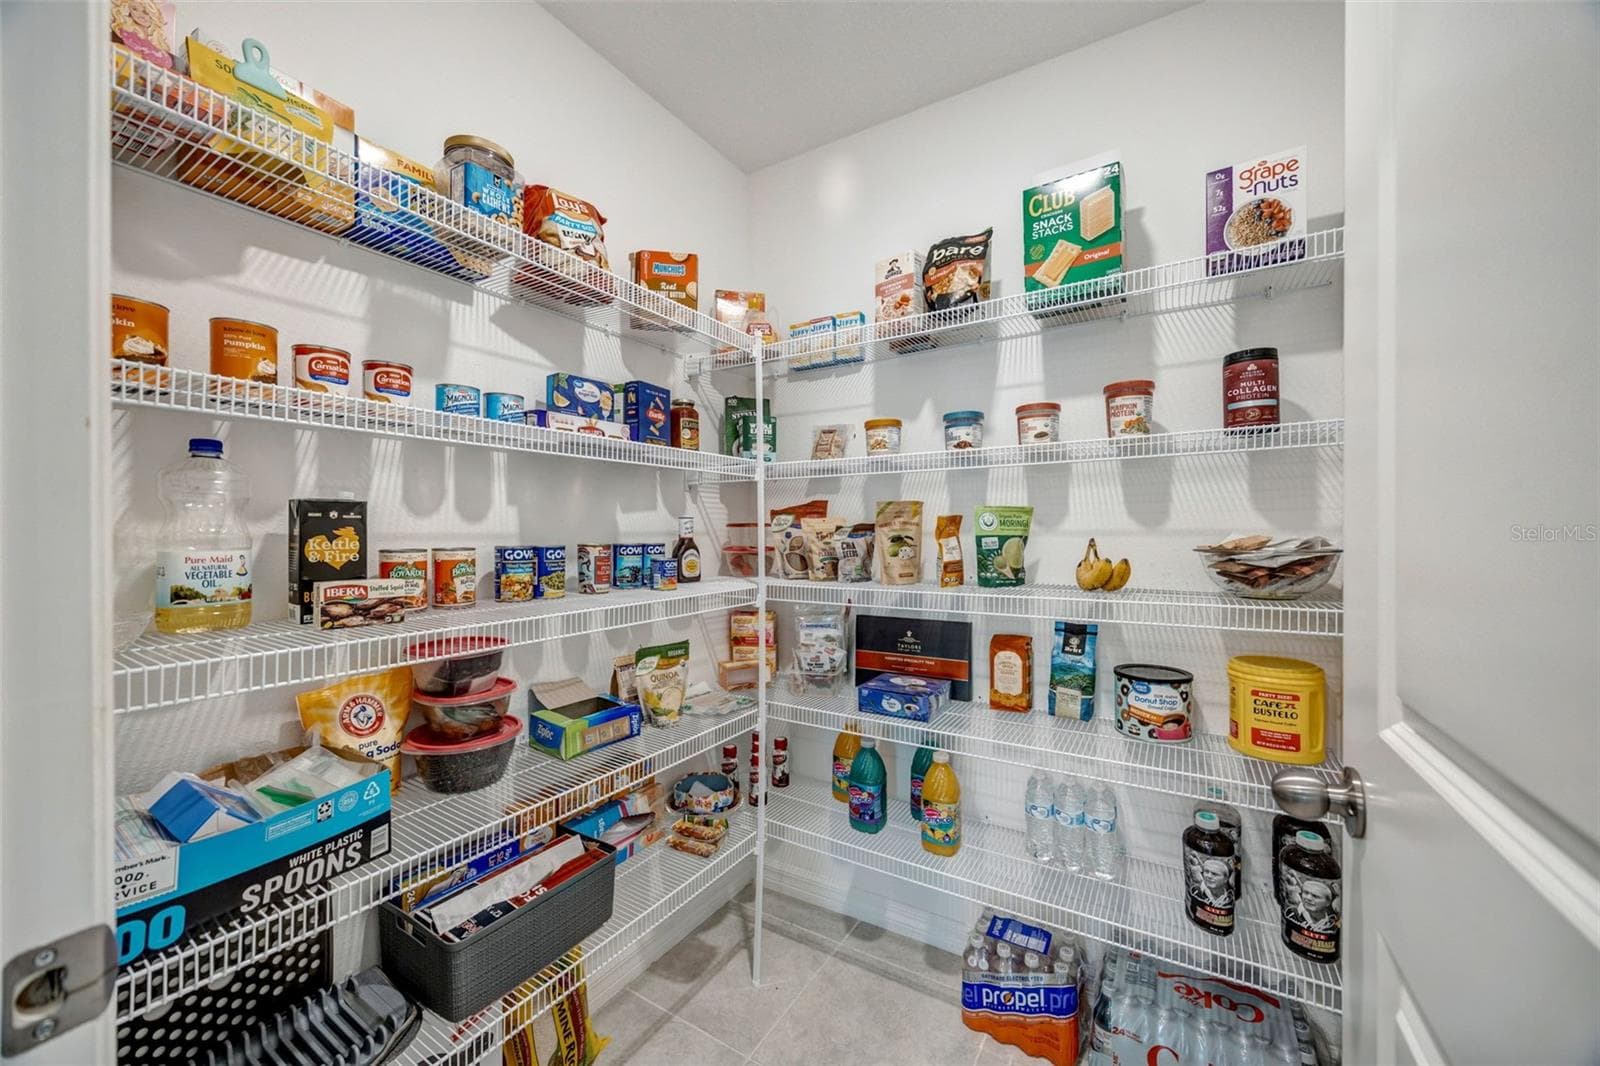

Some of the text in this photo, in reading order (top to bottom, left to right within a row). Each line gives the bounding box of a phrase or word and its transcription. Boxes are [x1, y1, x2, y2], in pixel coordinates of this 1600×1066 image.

[1103, 164, 1120, 176] 24
[1239, 158, 1300, 190] grape
[551, 192, 590, 214] Lay's
[1028, 189, 1075, 218] CLUB
[1032, 212, 1073, 231] SNACK
[1032, 222, 1074, 240] STACKS
[1083, 248, 1110, 261] Original
[223, 338, 266, 352] Pumpkin
[1240, 380, 1265, 388] MULTI
[1227, 385, 1278, 397] COLLAGEN
[308, 538, 360, 551] Kettle
[184, 555, 233, 564] Pure Maid
[308, 550, 360, 563] & Fire
[184, 569, 233, 580] VEGETABLE
[201, 579, 217, 588] OIL
[369, 584, 389, 593] Stuffed
[325, 587, 367, 598] IBERIA
[649, 671, 680, 683] QUINOA
[355, 697, 384, 717] HAMMER
[1134, 695, 1178, 706] Donut Shop
[1253, 707, 1299, 720] BUSTELO
[358, 740, 378, 751] pure
[375, 741, 401, 756] Soda
[288, 828, 364, 868] WHITE PLASTIC
[114, 861, 144, 873] mber's
[114, 871, 145, 886] OOD
[239, 841, 363, 913] SPOONS
[115, 880, 158, 901] VICE
[116, 904, 186, 966] 00
[982, 987, 1045, 1010] propel
[1173, 980, 1265, 1023] Coke
[556, 1000, 574, 1042] MINE
[1112, 1026, 1125, 1036] 24
